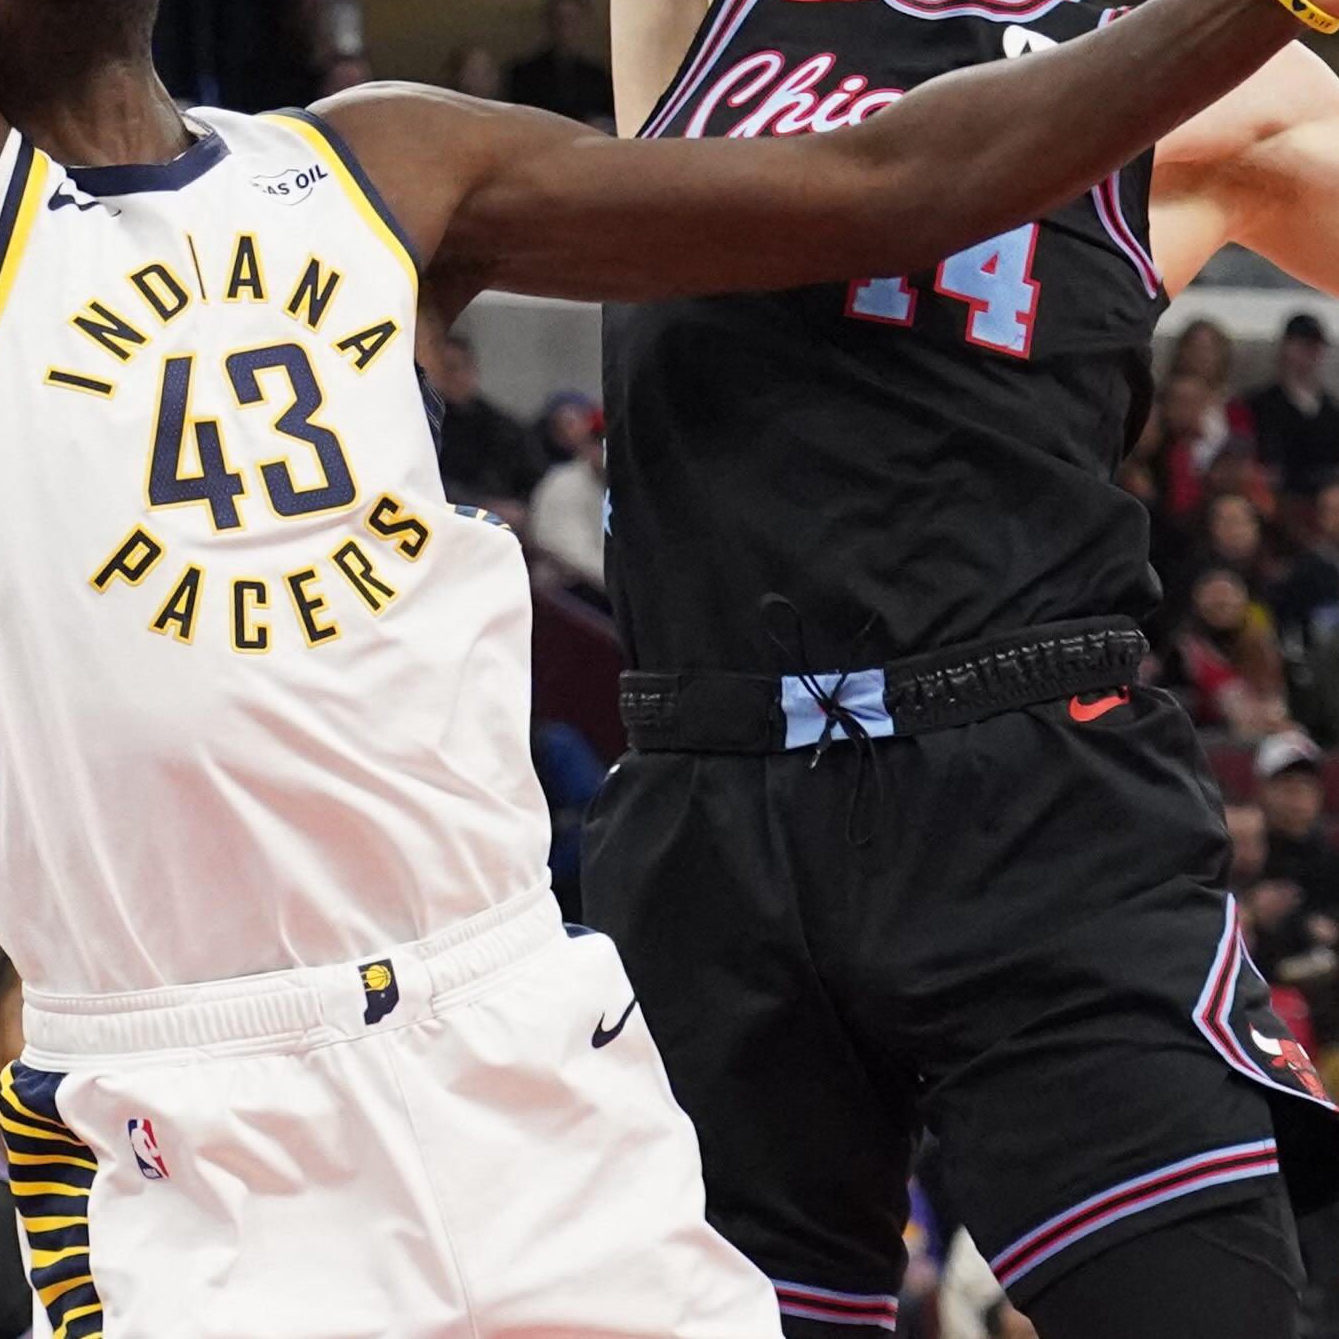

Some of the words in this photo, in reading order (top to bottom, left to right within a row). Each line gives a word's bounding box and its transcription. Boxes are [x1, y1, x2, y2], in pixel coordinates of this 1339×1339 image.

[295, 164, 328, 189] OIL
[144, 339, 361, 537] 43
[87, 491, 433, 654] PACERS
